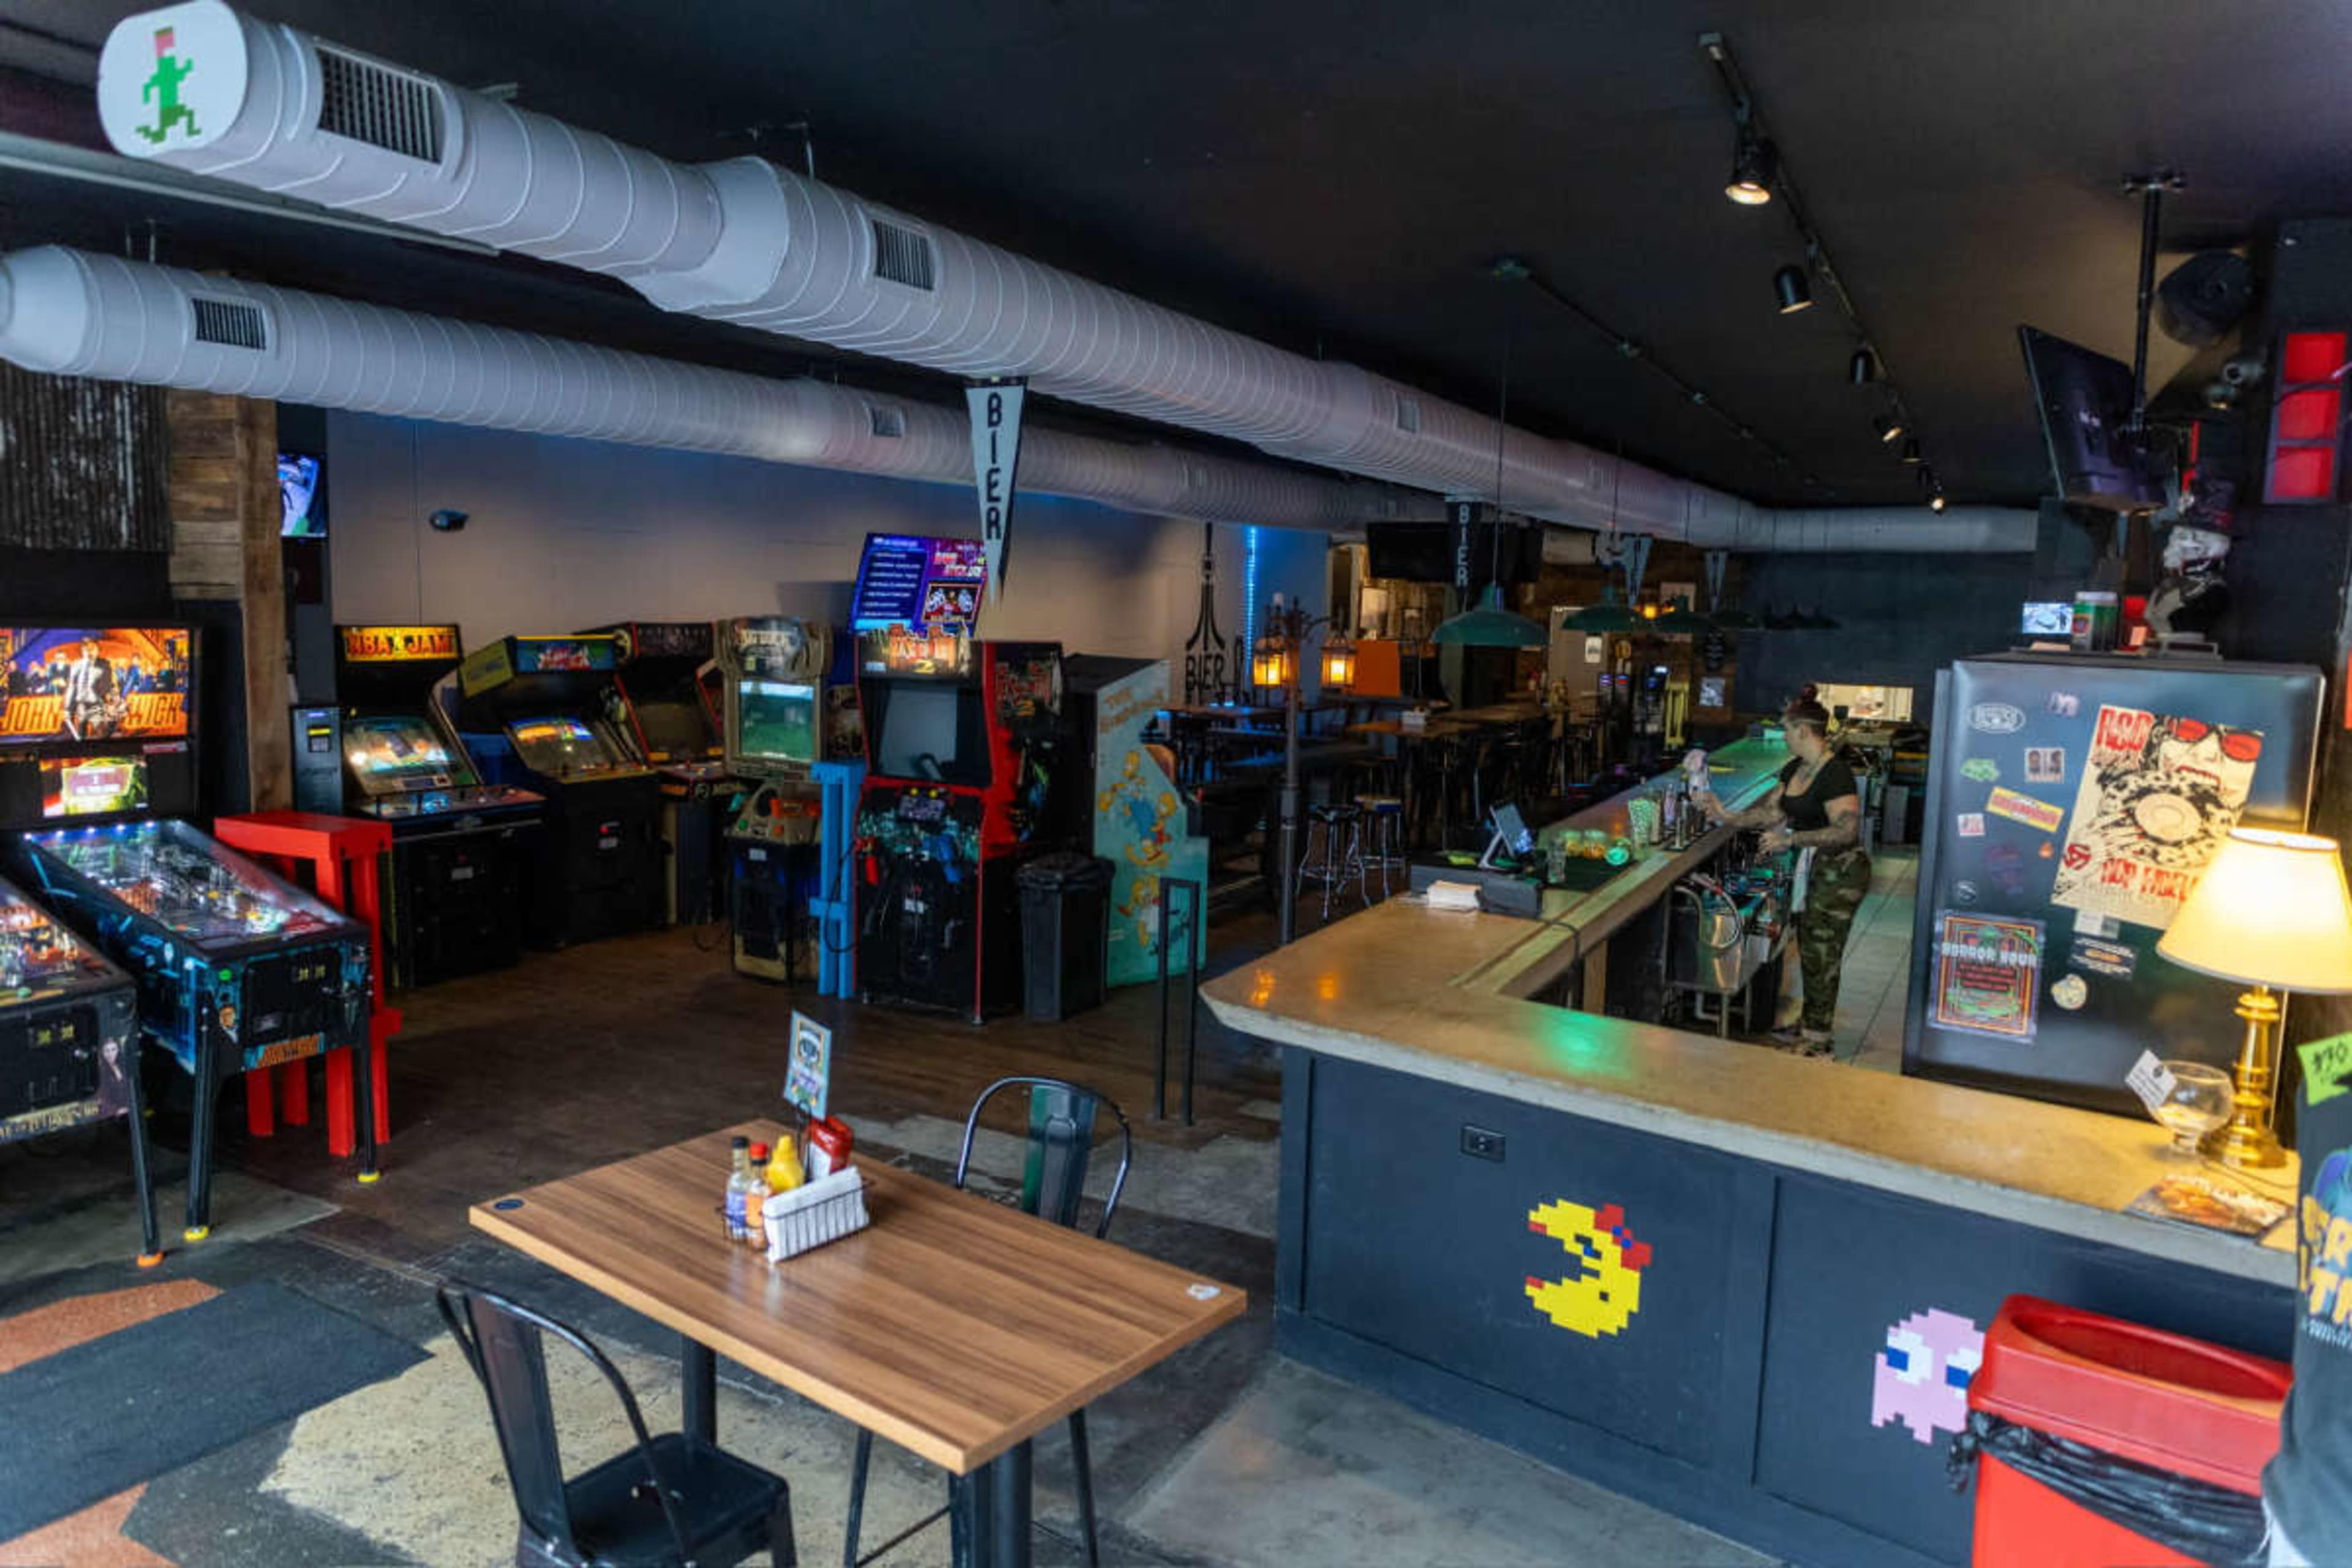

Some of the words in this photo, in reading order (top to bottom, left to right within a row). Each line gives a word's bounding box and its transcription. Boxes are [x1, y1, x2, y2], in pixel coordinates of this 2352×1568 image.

[985, 392, 1003, 540] BIER
[1457, 504, 1470, 588] BIER
[348, 633, 391, 656] NBA
[404, 633, 453, 654] JAM
[1185, 654, 1224, 691] BIER
[1, 695, 64, 735] JOHN
[125, 692, 184, 729] WICK
